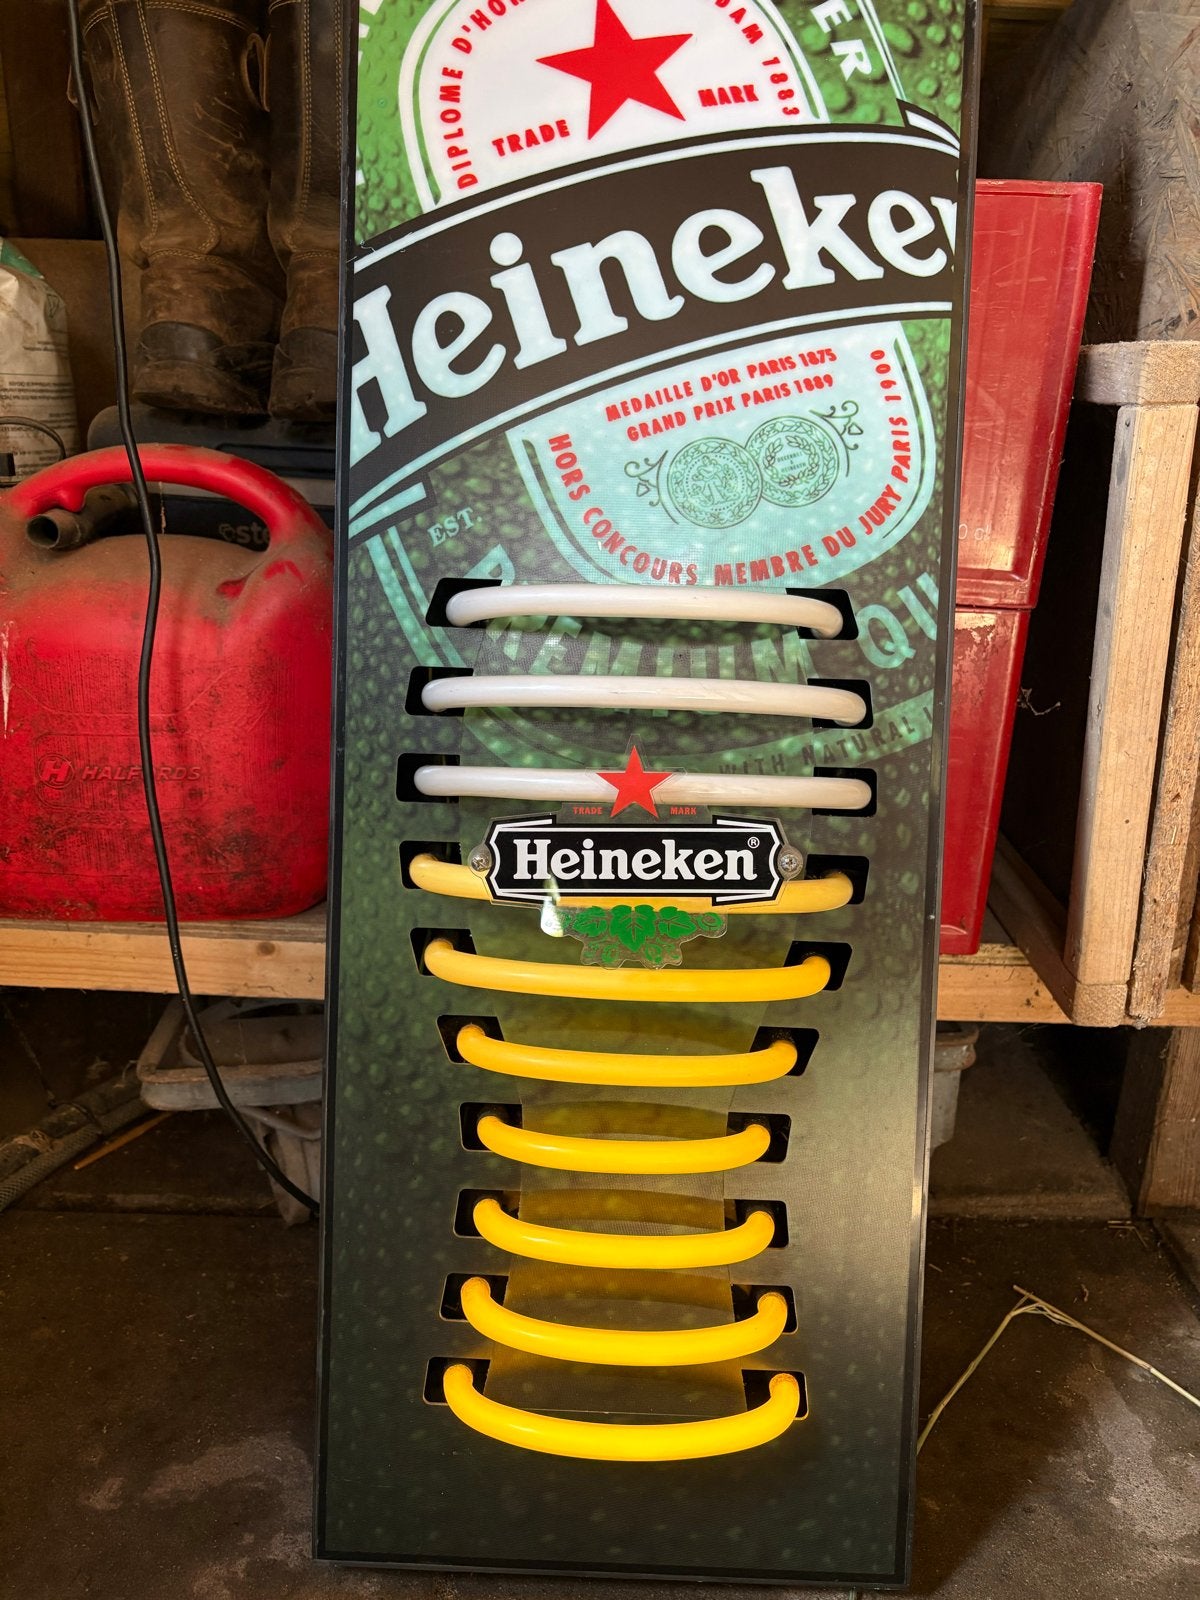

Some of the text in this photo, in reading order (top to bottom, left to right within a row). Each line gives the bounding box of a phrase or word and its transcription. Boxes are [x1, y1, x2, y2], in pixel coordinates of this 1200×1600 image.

[439, 0, 525, 189] DIPLOME D'HO
[762, 57, 800, 116] 1883
[491, 84, 759, 157] TRADE MARK
[605, 348, 838, 422] MEDAILLE D'OR PARIS 1875
[626, 373, 834, 442] GRAND PRIX PARIS 1889
[548, 349, 912, 587] HORS CONCOURS MEMBRE DU JURY PARIS 1900
[426, 506, 483, 548] EST.
[801, 715, 916, 766] NATURAL
[82, 766, 202, 781] HALFRDS
[573, 806, 697, 815] TRADE MARK
